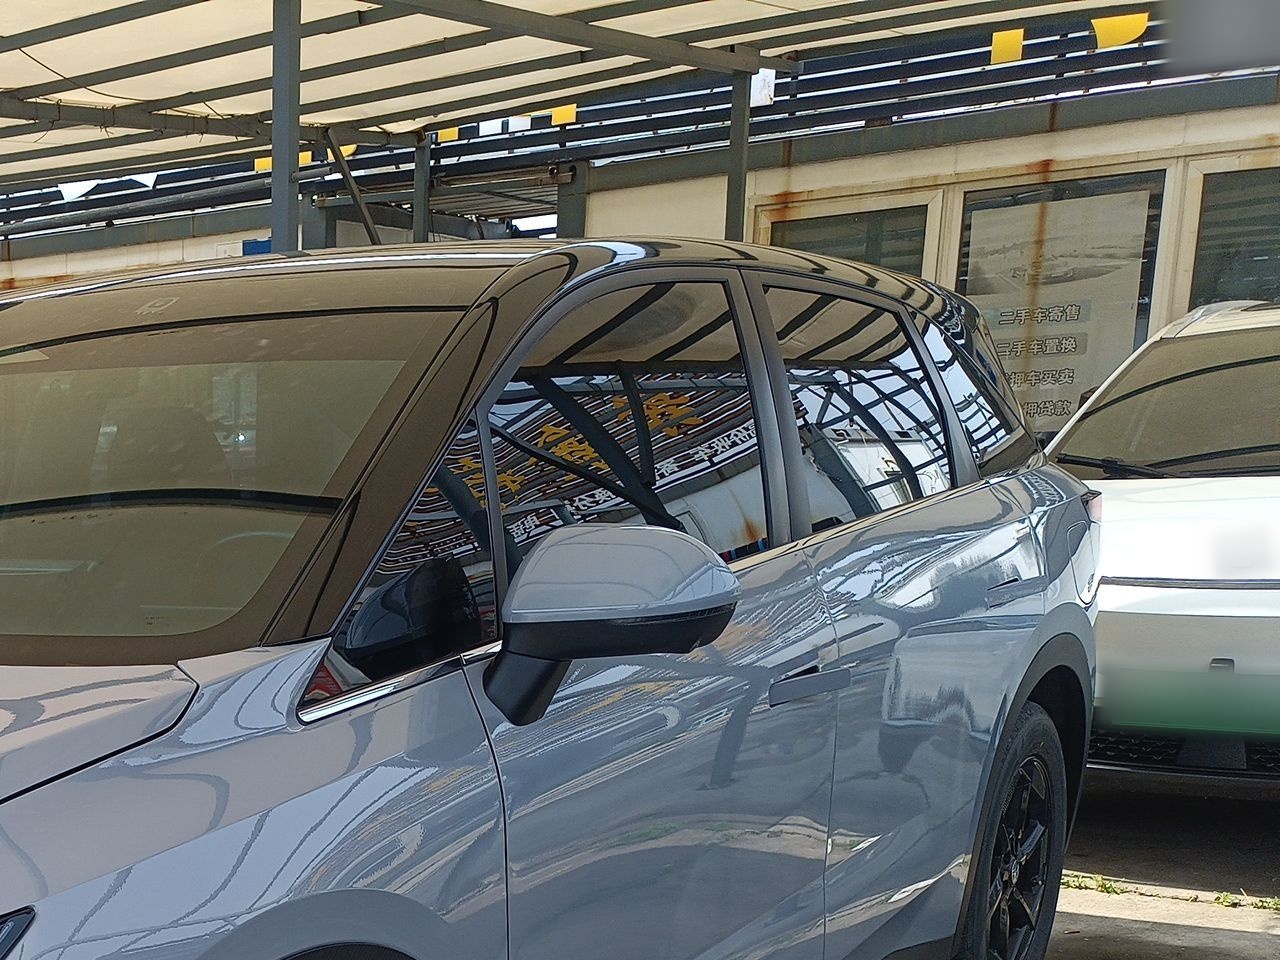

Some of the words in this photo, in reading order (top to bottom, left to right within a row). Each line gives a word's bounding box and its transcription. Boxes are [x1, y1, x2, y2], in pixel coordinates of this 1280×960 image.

[999, 304, 1081, 326] 二手车寄售
[997, 336, 1078, 357] 二手车置换
[1006, 368, 1074, 388] 押车买卖
